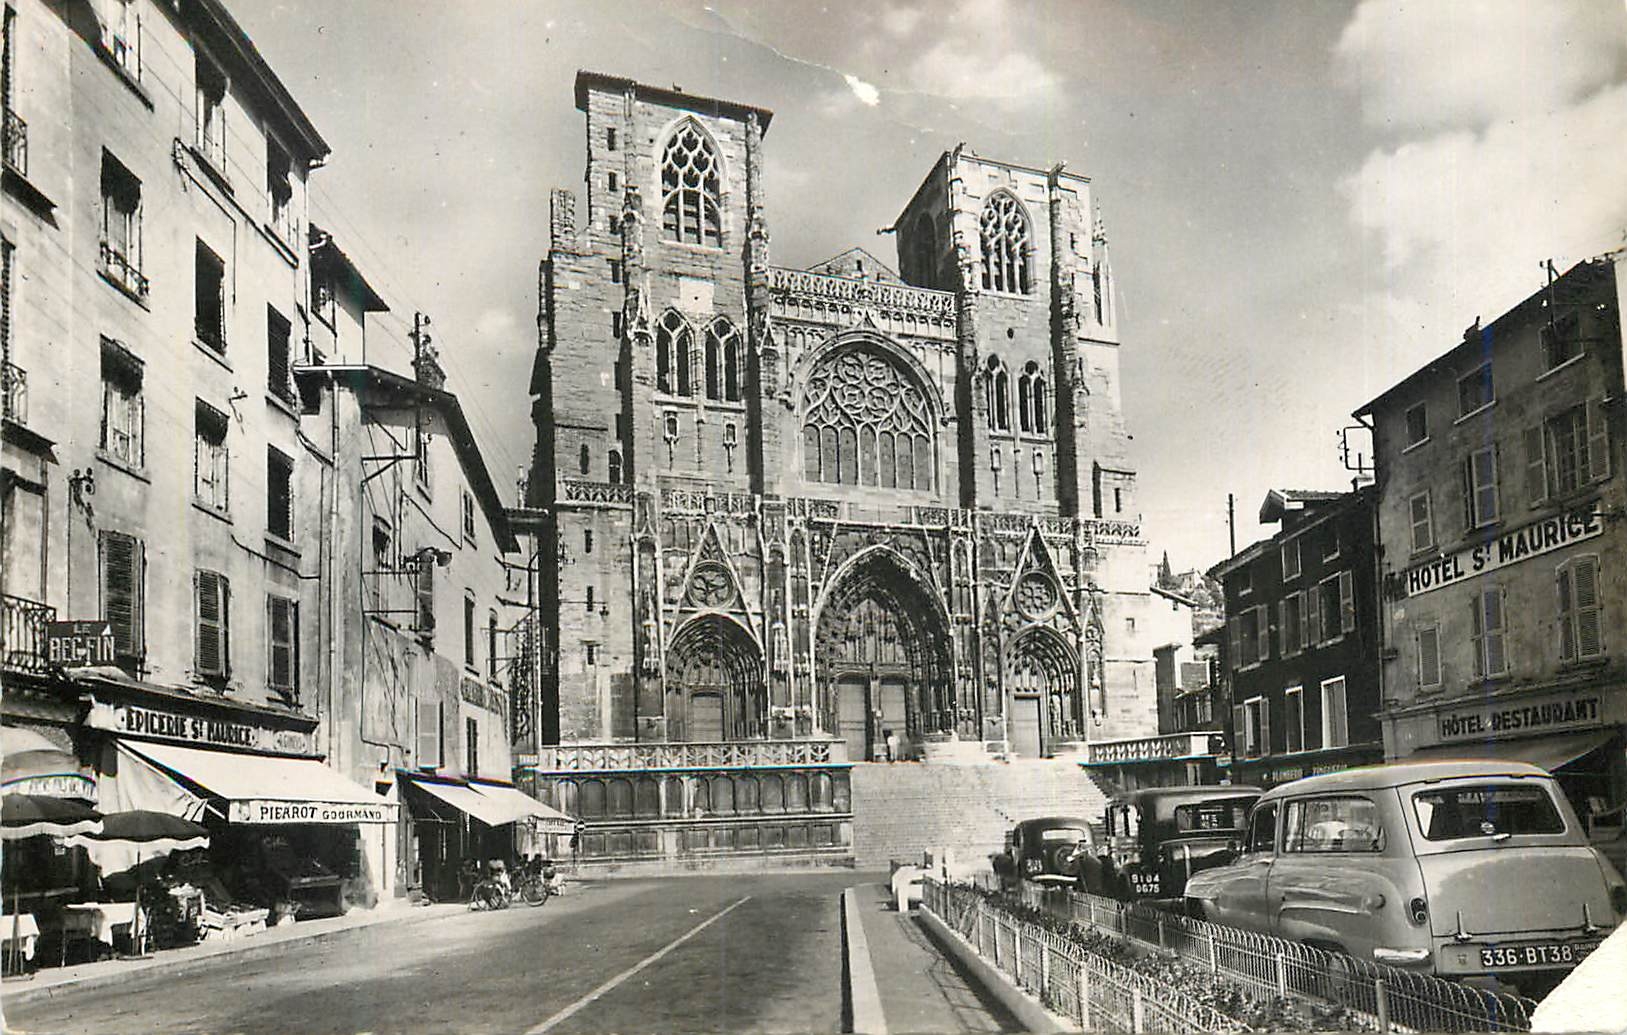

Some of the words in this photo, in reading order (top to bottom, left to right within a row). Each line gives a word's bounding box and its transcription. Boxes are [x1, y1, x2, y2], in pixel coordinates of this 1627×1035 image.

[1410, 556, 1464, 592] HOTEL
[1499, 508, 1599, 563] MAURICE
[74, 623, 91, 634] LE
[1493, 698, 1598, 730] RESTAURANT
[207, 720, 252, 746] MAURICE
[260, 806, 318, 820] PIERROT
[322, 810, 382, 820] GOURMAND
